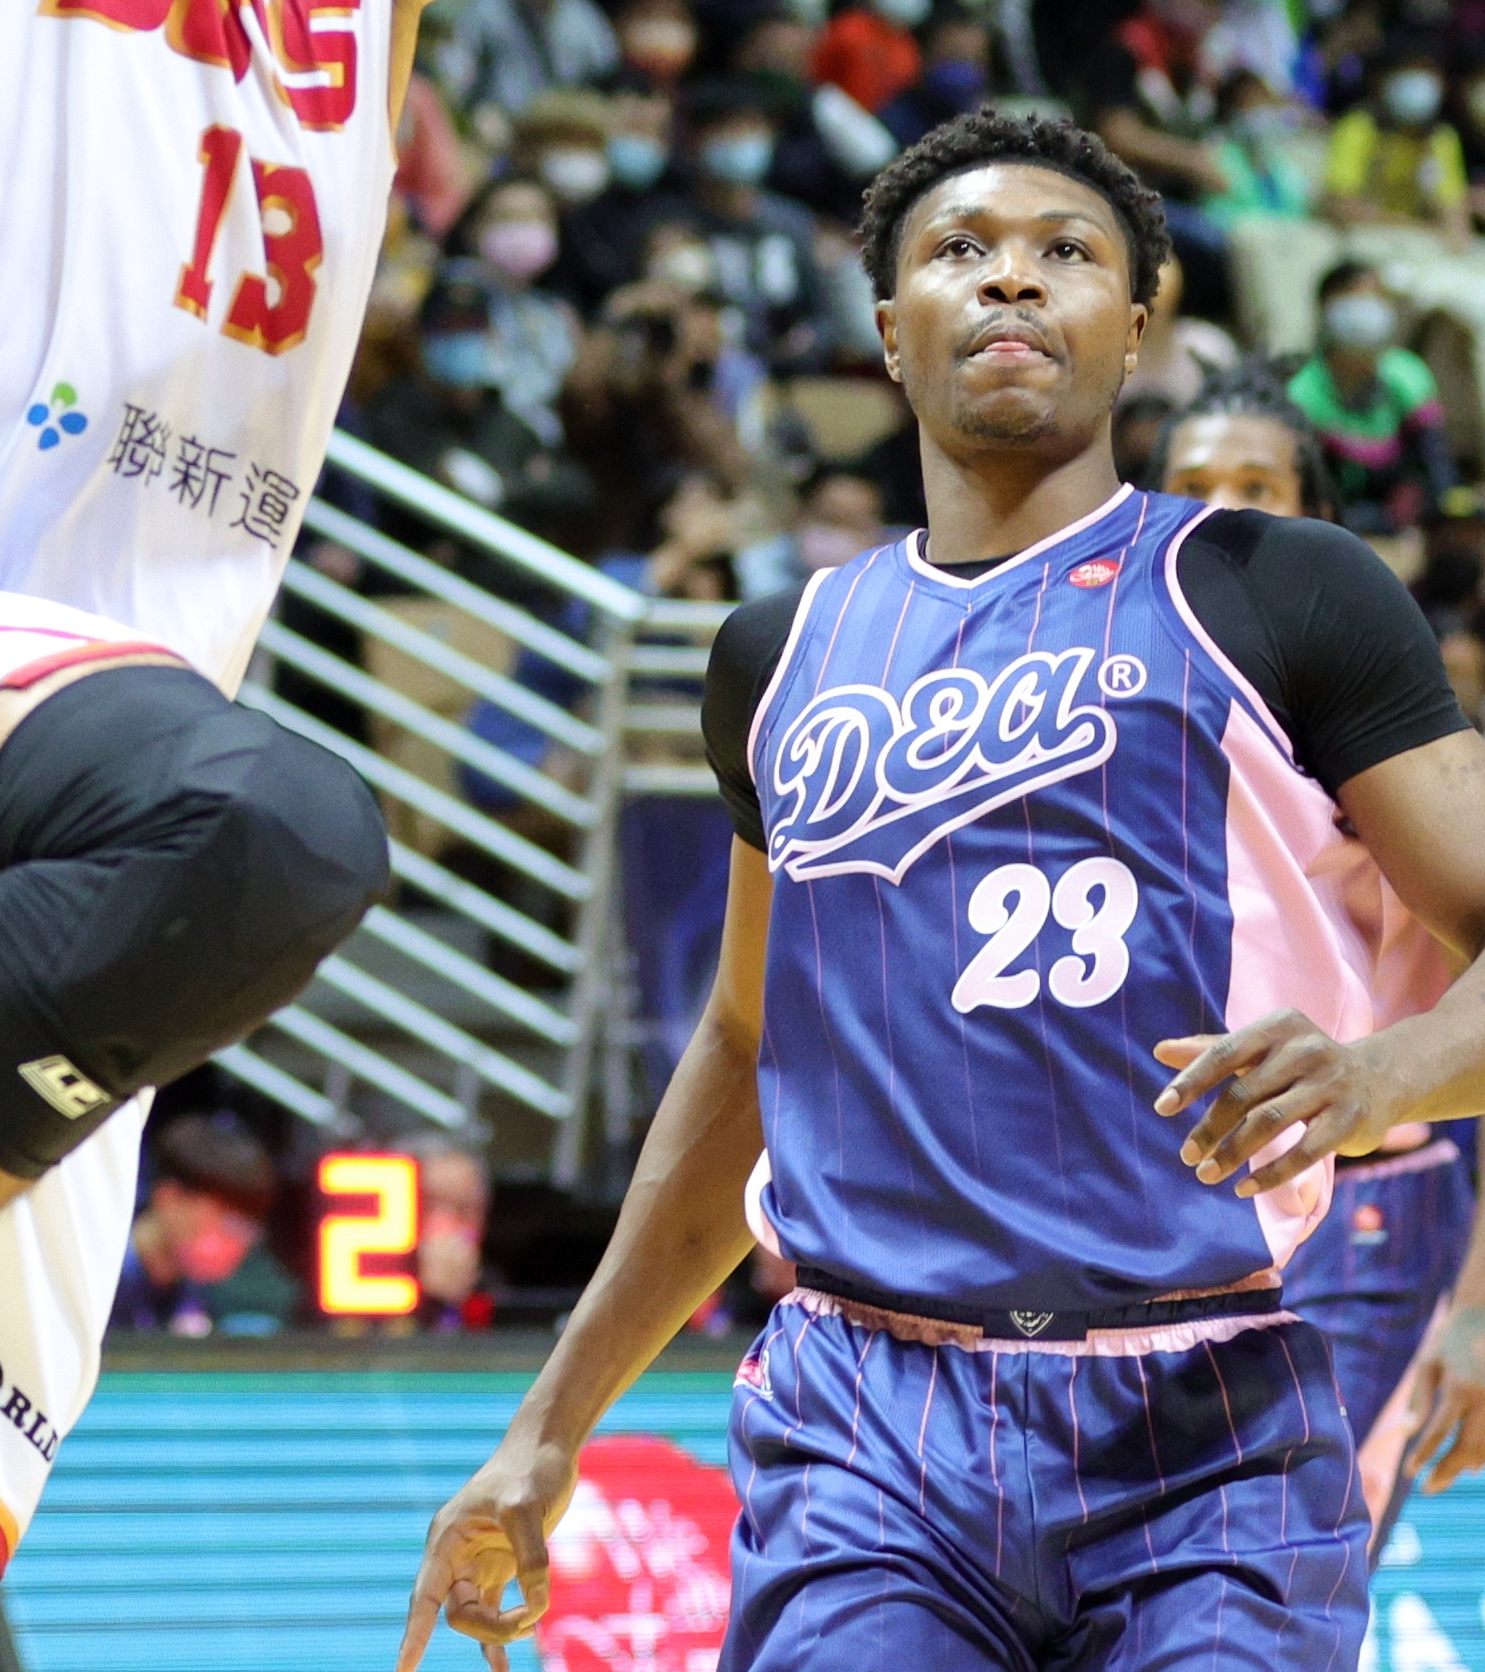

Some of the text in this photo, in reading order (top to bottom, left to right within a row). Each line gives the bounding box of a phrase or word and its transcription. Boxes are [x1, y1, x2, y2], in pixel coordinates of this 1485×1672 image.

[172, 122, 324, 358] 13
[104, 401, 302, 550] 聯新運
[951, 857, 1139, 1014] 23
[316, 1151, 421, 1316] 2
